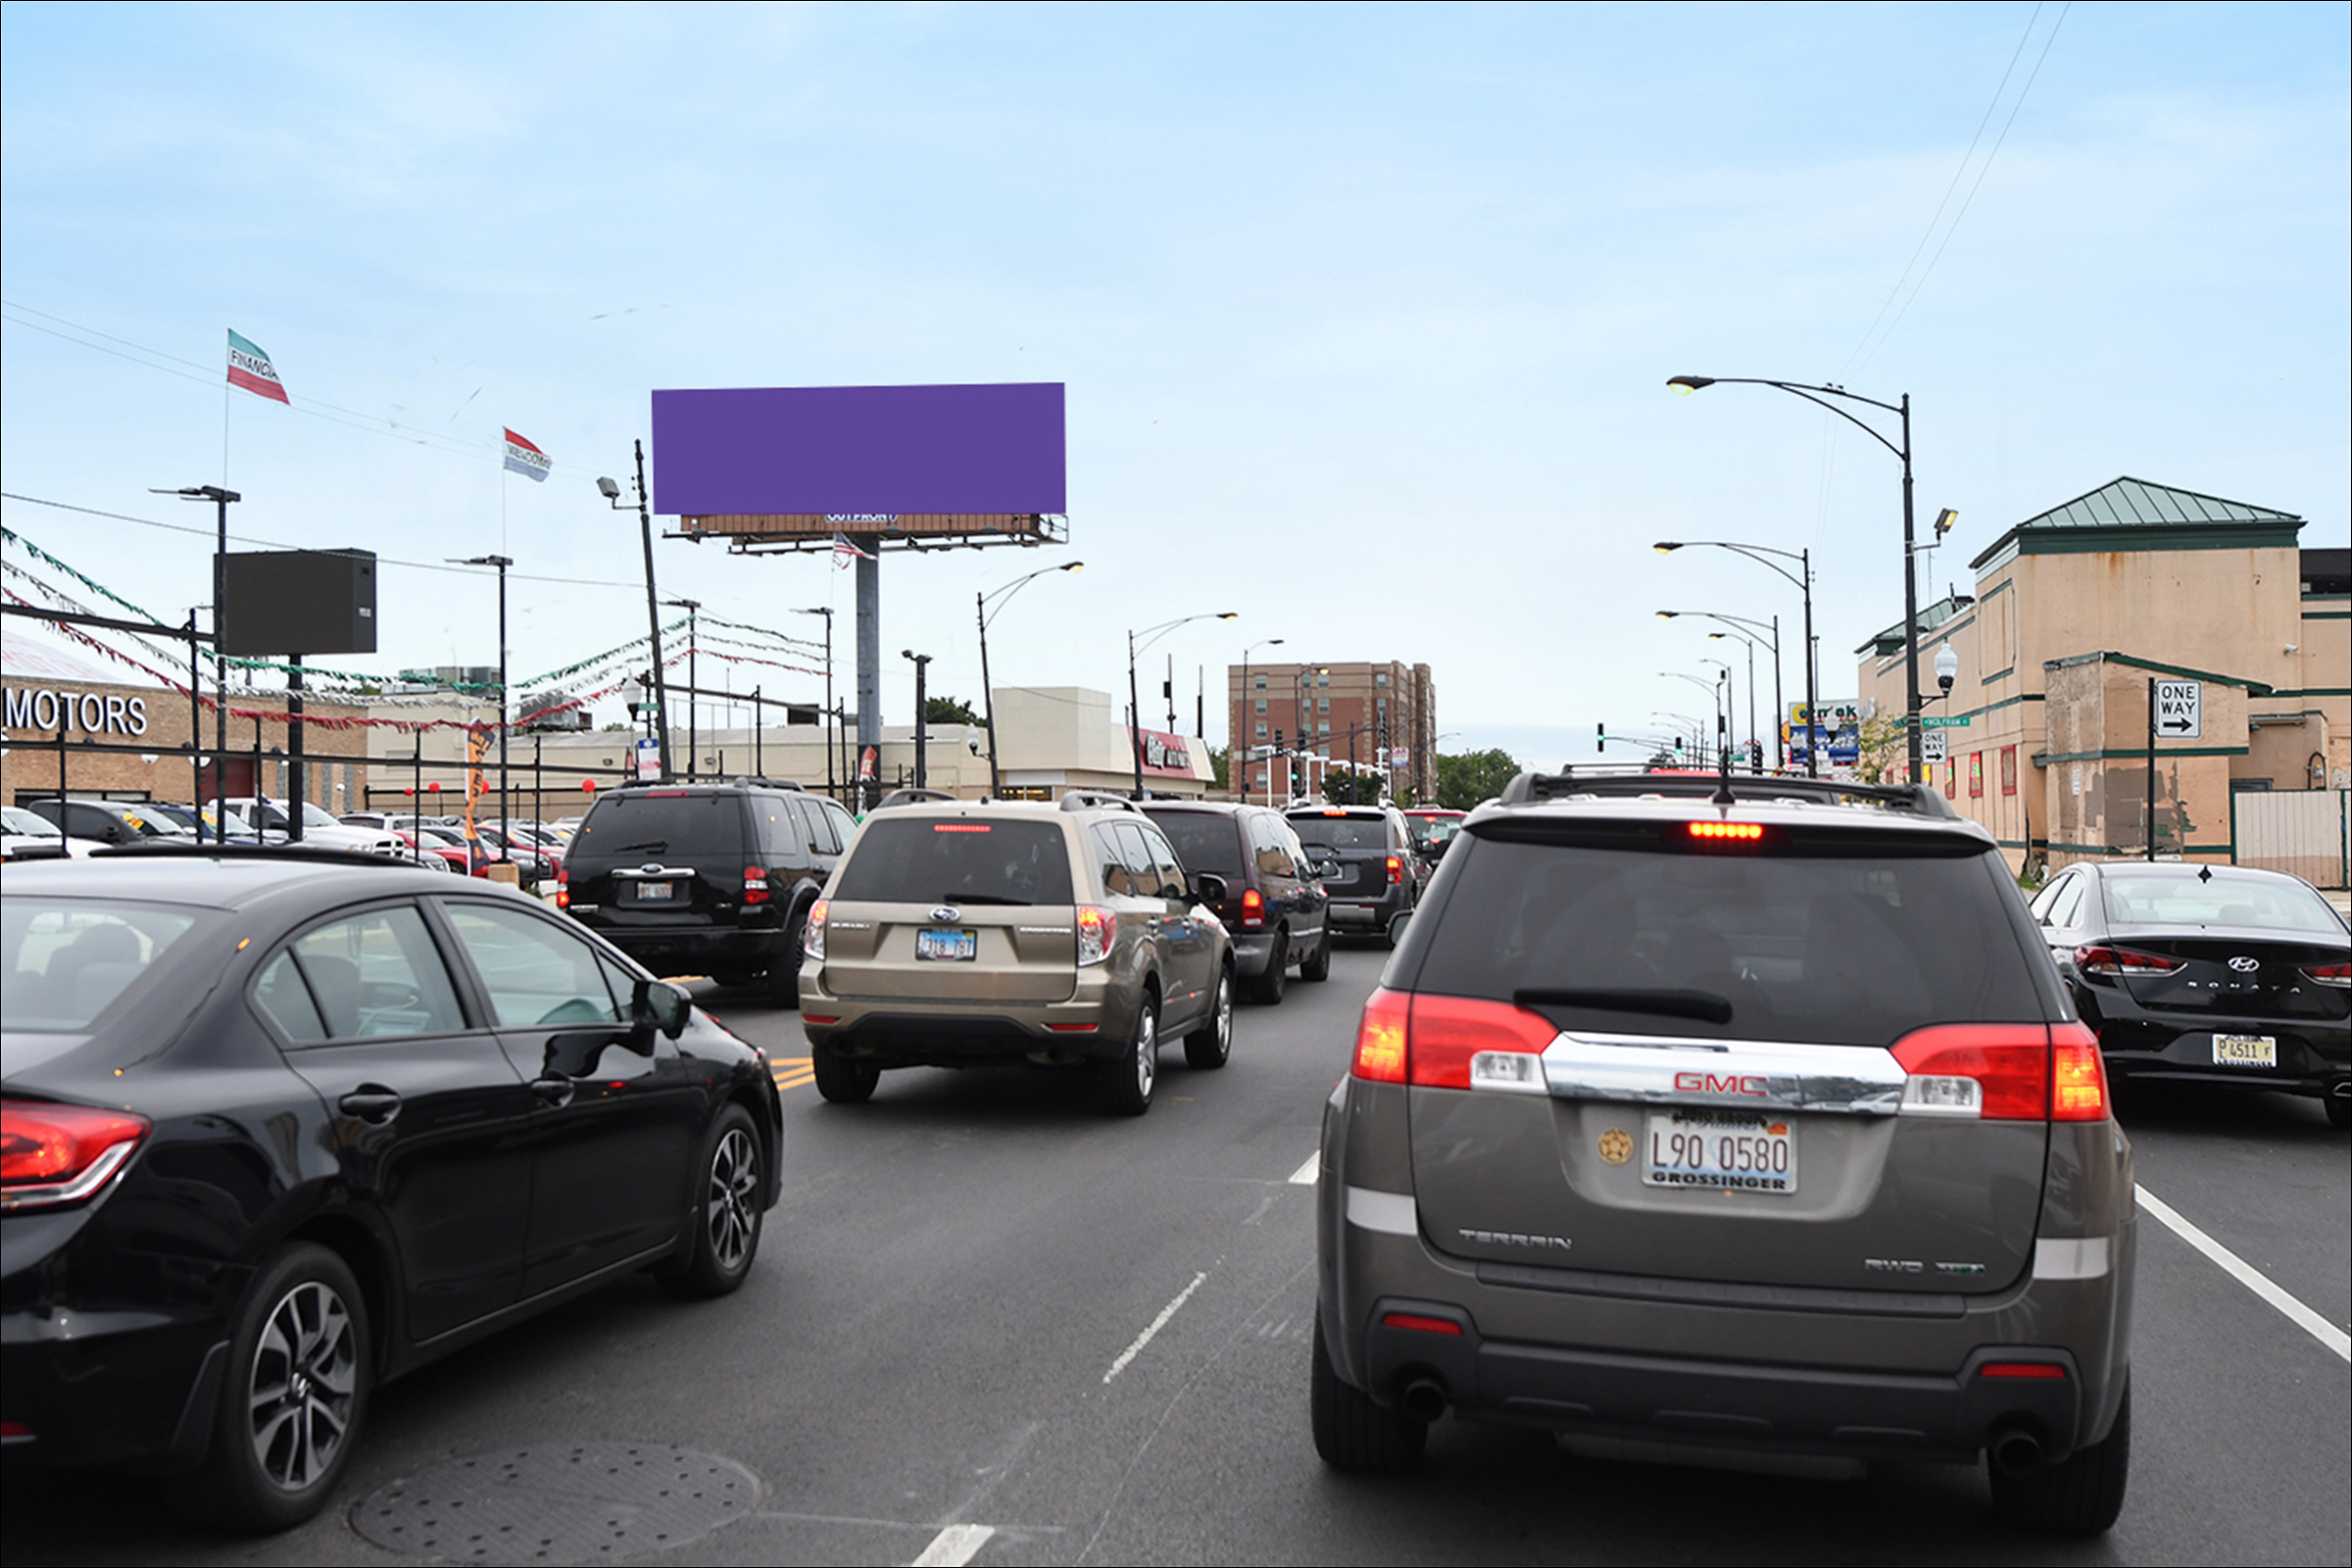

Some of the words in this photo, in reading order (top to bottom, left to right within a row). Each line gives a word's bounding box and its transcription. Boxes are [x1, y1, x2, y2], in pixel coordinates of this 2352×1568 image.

[2162, 686, 2195, 699] ONE
[2, 687, 147, 735] MOTORS
[2161, 701, 2196, 714] WAY
[1924, 733, 1943, 742] ONE
[2230, 1043, 2258, 1058] 4511
[1675, 1071, 1767, 1096] GMC
[1652, 1132, 1703, 1169] L90
[1719, 1136, 1788, 1174] 0580
[1651, 1171, 1787, 1190] GROSSINGER
